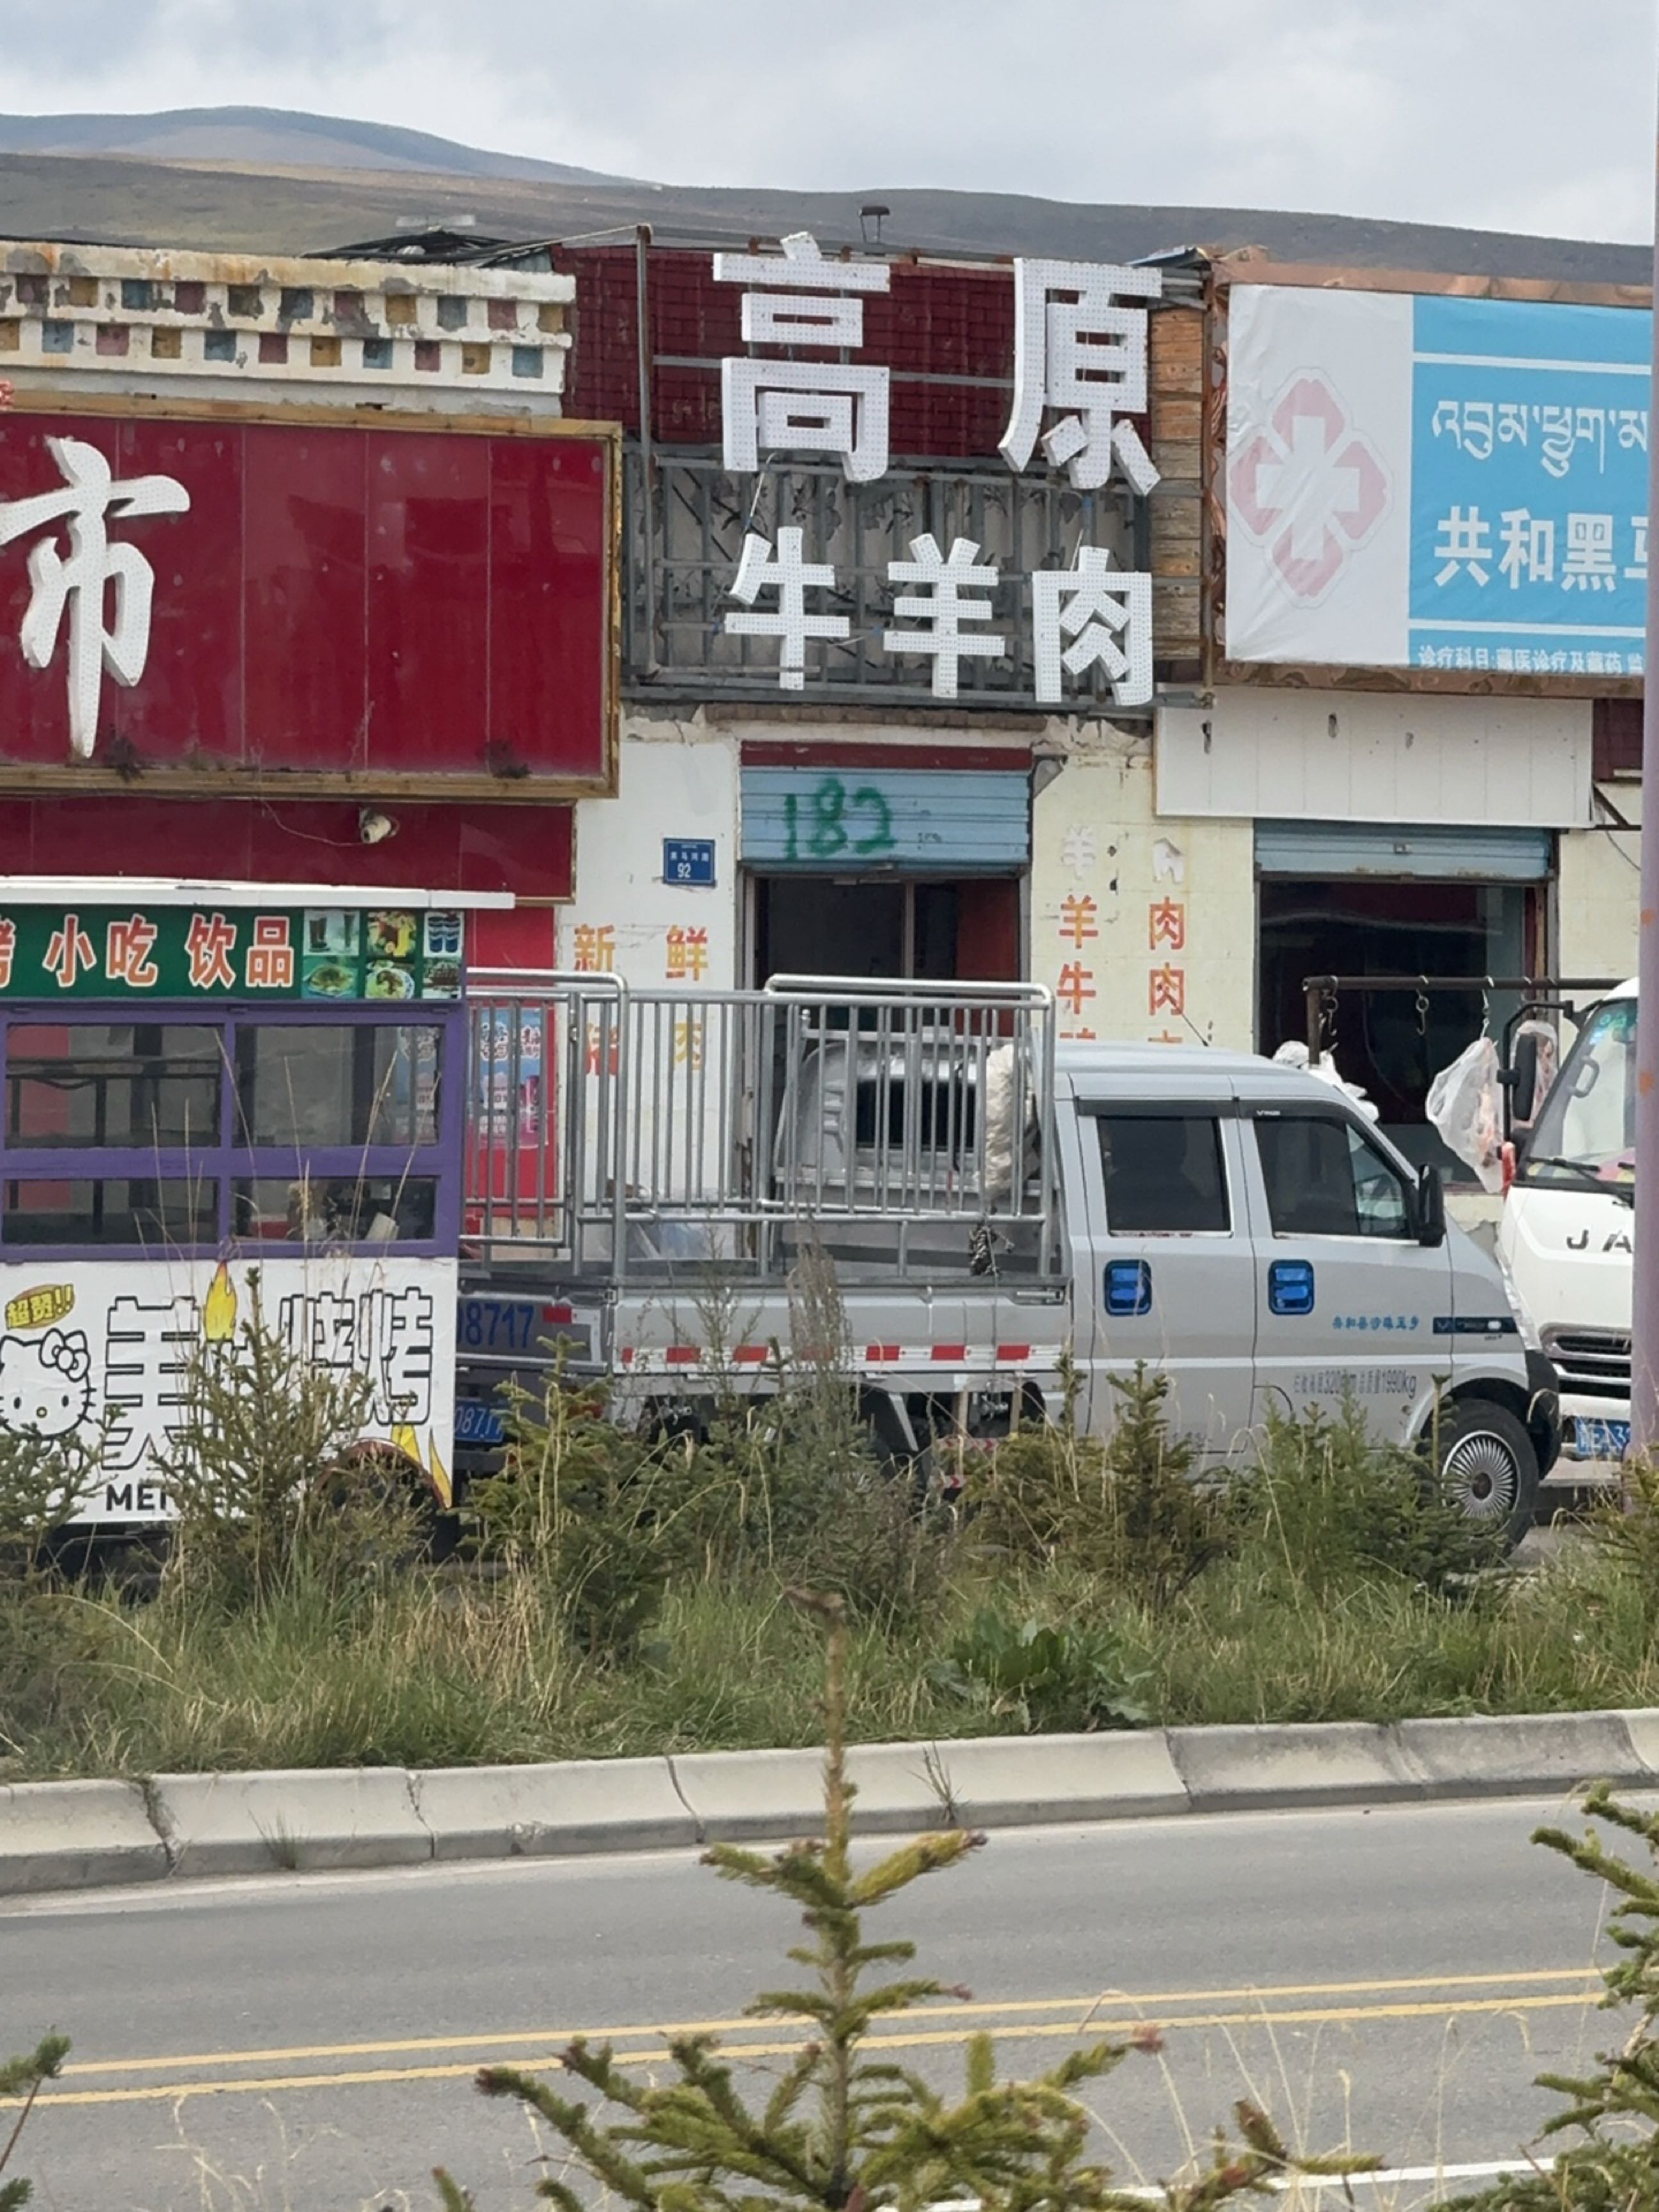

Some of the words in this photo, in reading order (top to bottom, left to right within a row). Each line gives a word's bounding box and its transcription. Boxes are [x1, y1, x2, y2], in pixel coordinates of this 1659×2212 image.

[712, 230, 1162, 497] 高原
[0, 436, 191, 758] 市
[725, 525, 1153, 706] 牛羊肉
[677, 862, 691, 878] 92
[784, 776, 897, 861] 182
[42, 913, 159, 990] 小吃
[185, 913, 296, 990] 饮品
[100, 1286, 434, 1471] 美烧烤
